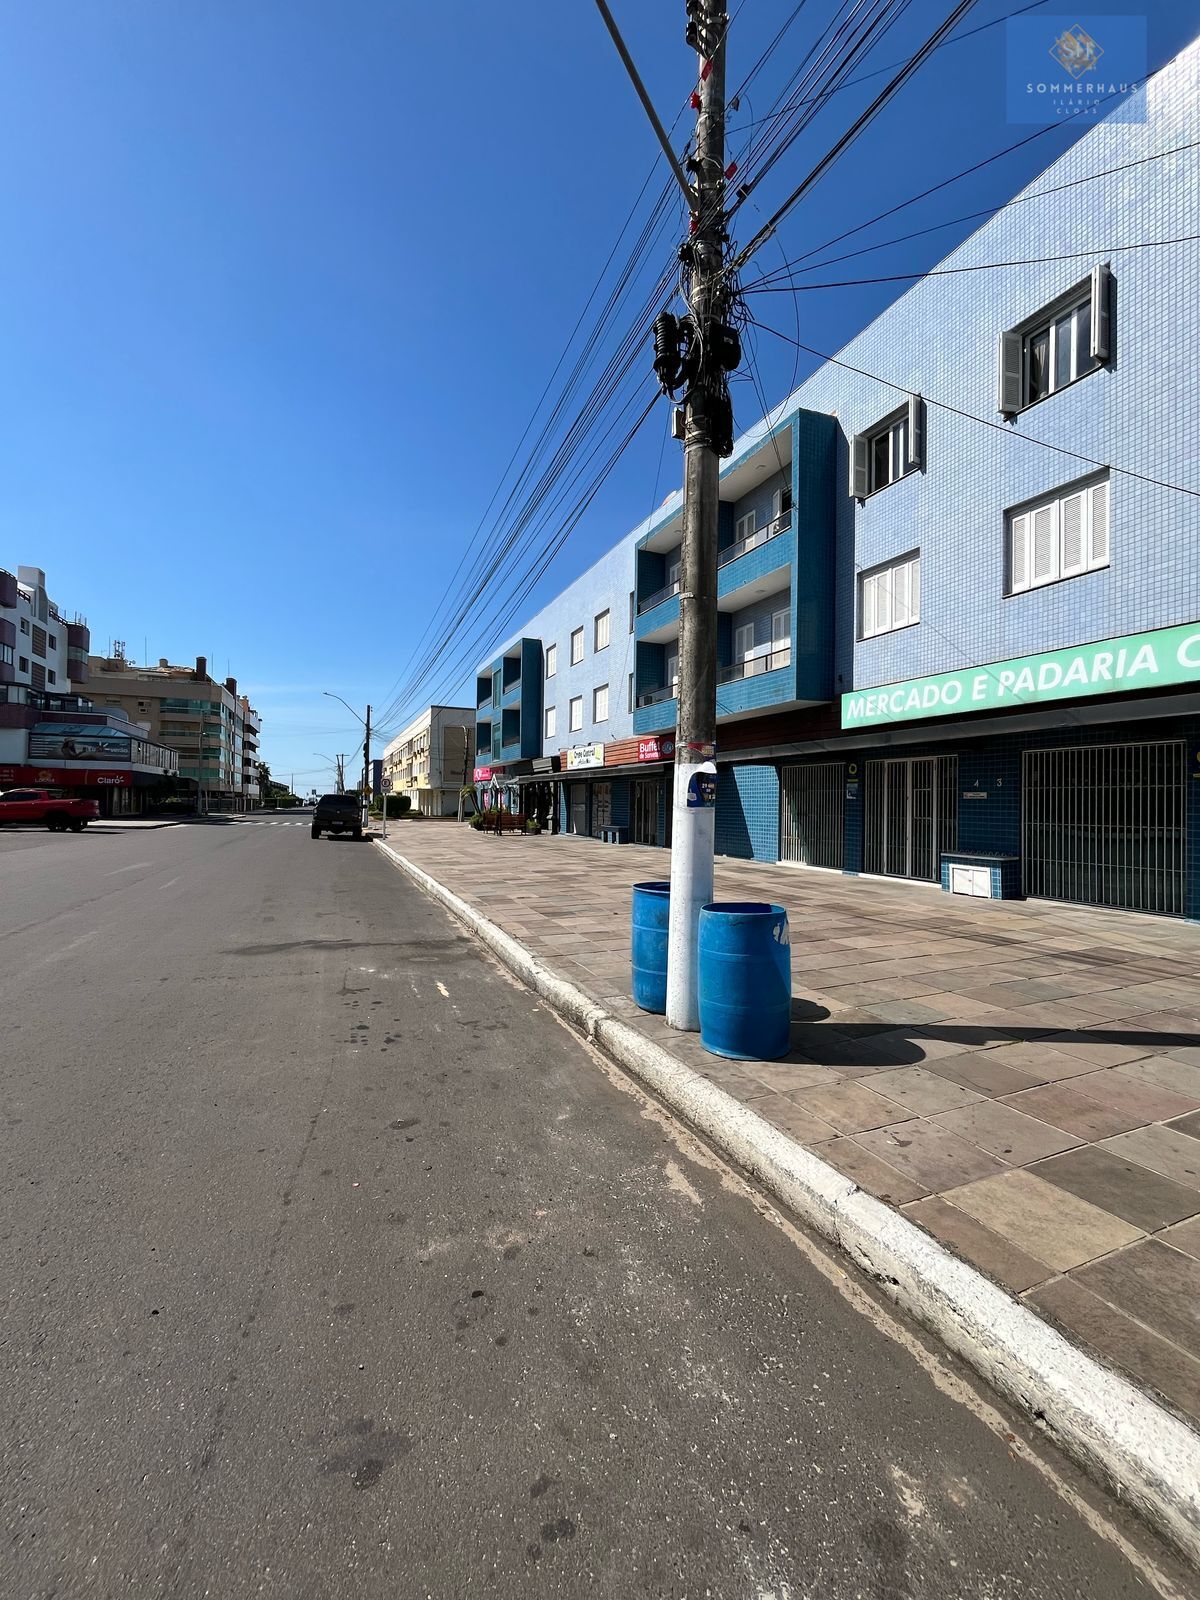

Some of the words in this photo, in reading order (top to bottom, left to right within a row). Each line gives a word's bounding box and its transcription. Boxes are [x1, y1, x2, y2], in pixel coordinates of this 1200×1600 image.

[846, 679, 962, 721] MERCADO
[972, 674, 990, 702] E
[997, 643, 1160, 697] PADARIA
[639, 741, 660, 753] Buffet
[97, 776, 122, 784] Claro
